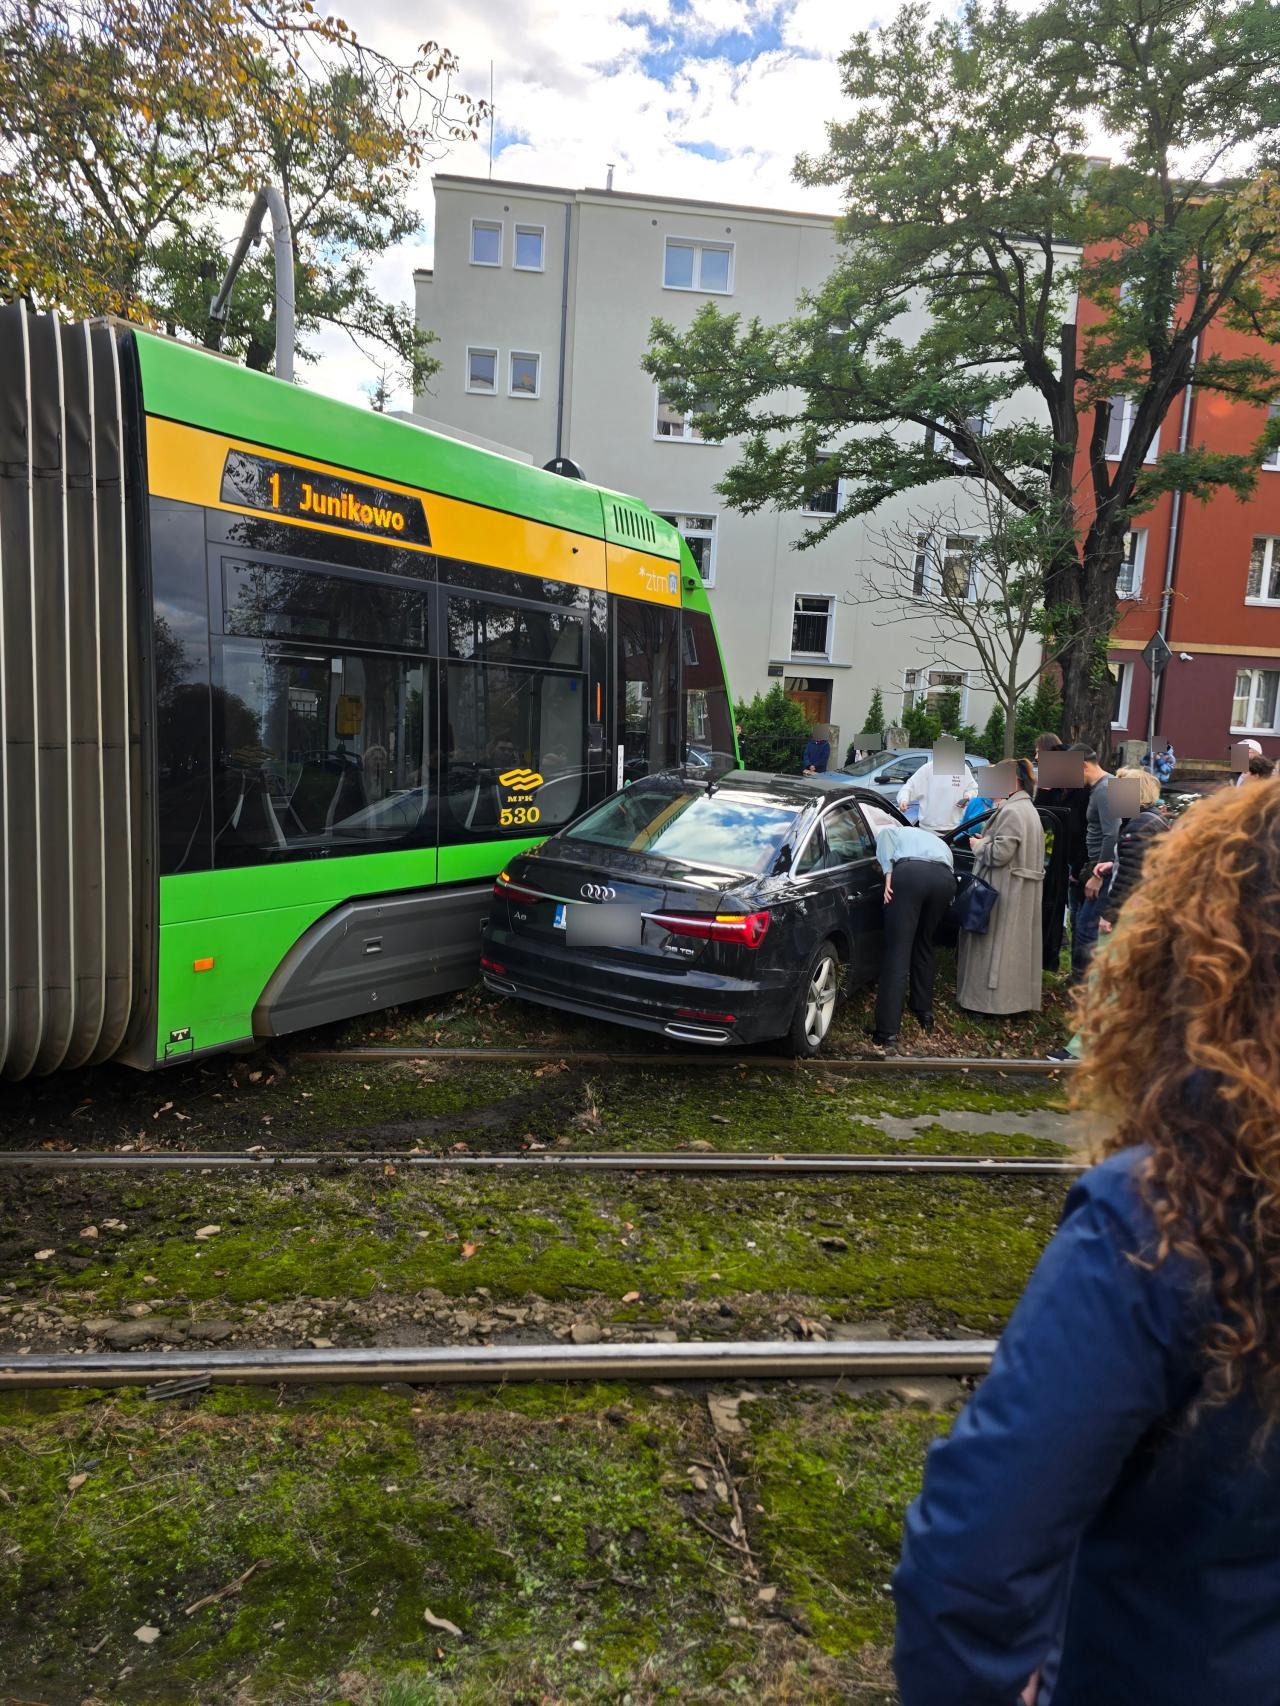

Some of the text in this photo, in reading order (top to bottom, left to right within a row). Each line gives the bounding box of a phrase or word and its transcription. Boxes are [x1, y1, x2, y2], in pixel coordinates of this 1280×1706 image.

[269, 472, 405, 531] 1 Junikowo
[507, 795, 534, 803] MPK
[500, 806, 540, 826] 530
